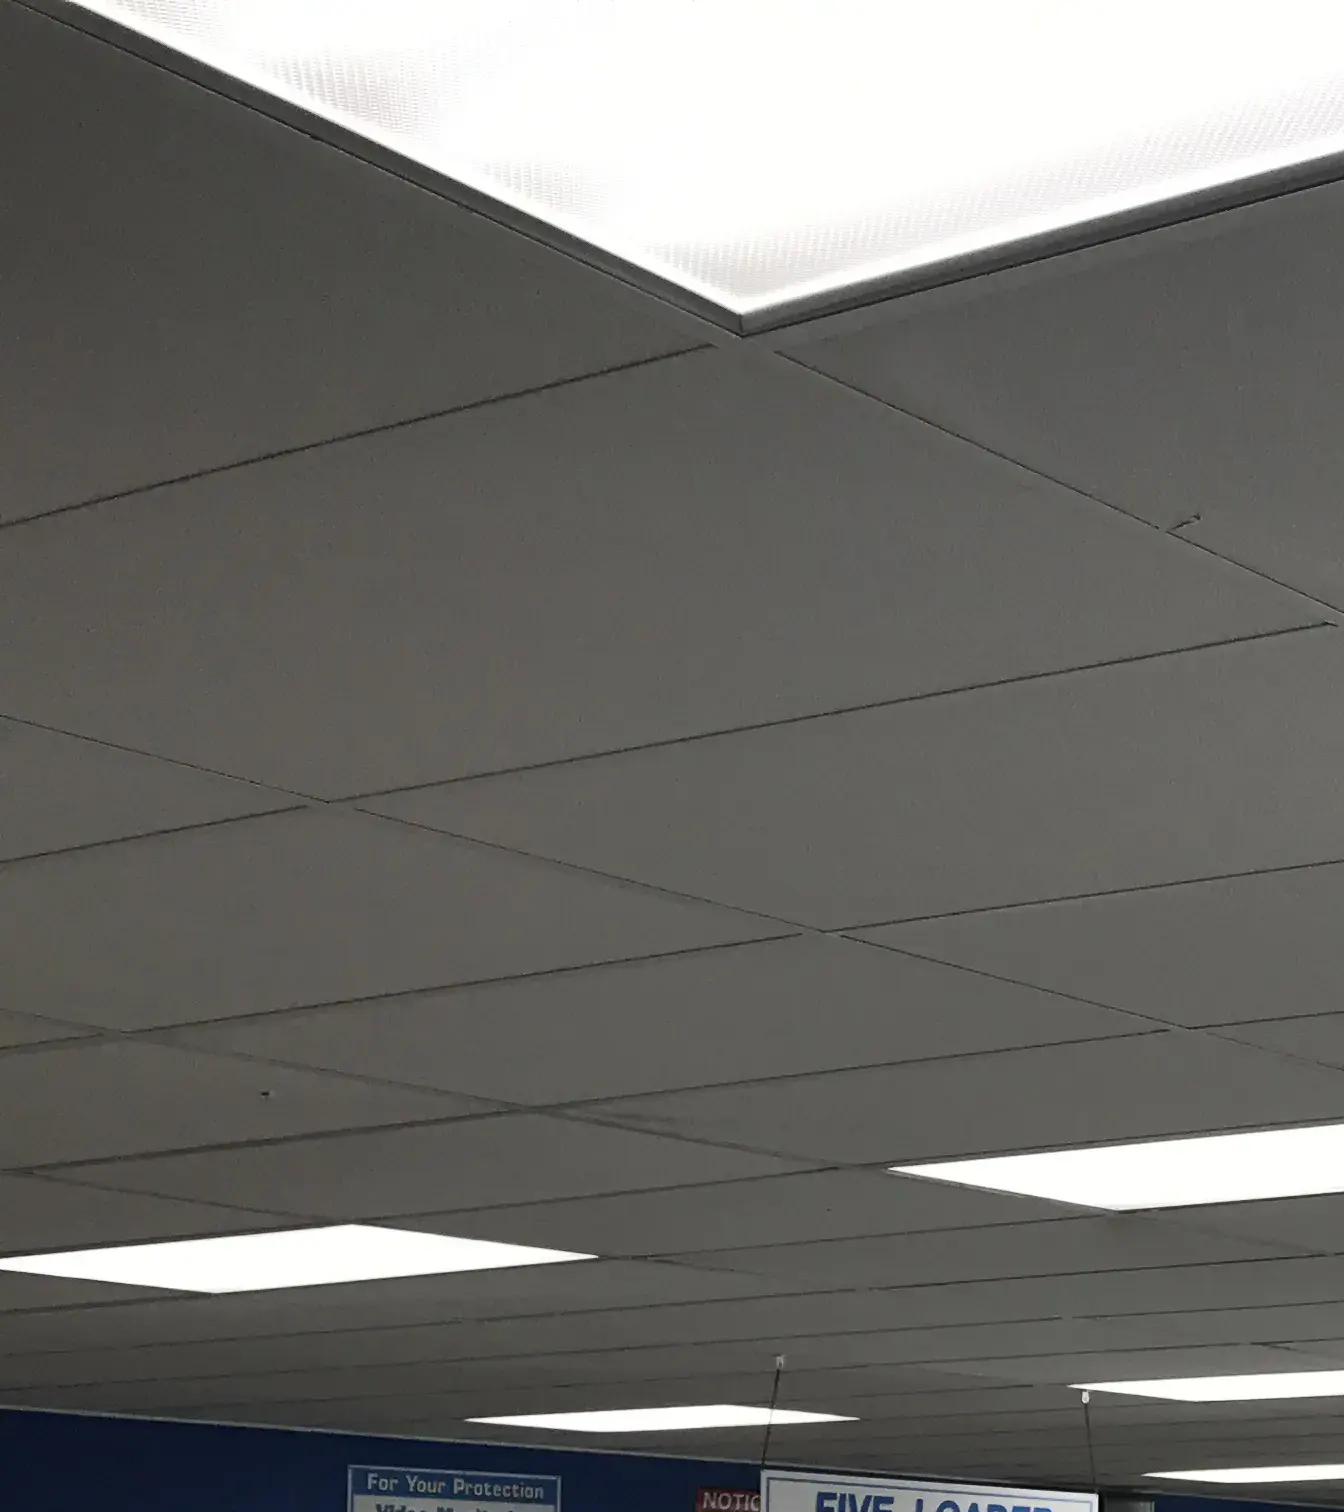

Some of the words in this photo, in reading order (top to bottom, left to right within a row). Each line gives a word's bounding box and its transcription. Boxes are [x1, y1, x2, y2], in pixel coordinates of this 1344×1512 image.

[366, 1473, 399, 1491] For
[405, 1475, 446, 1493] Your
[452, 1477, 544, 1500] Protection
[702, 1491, 761, 1512] NOTIC
